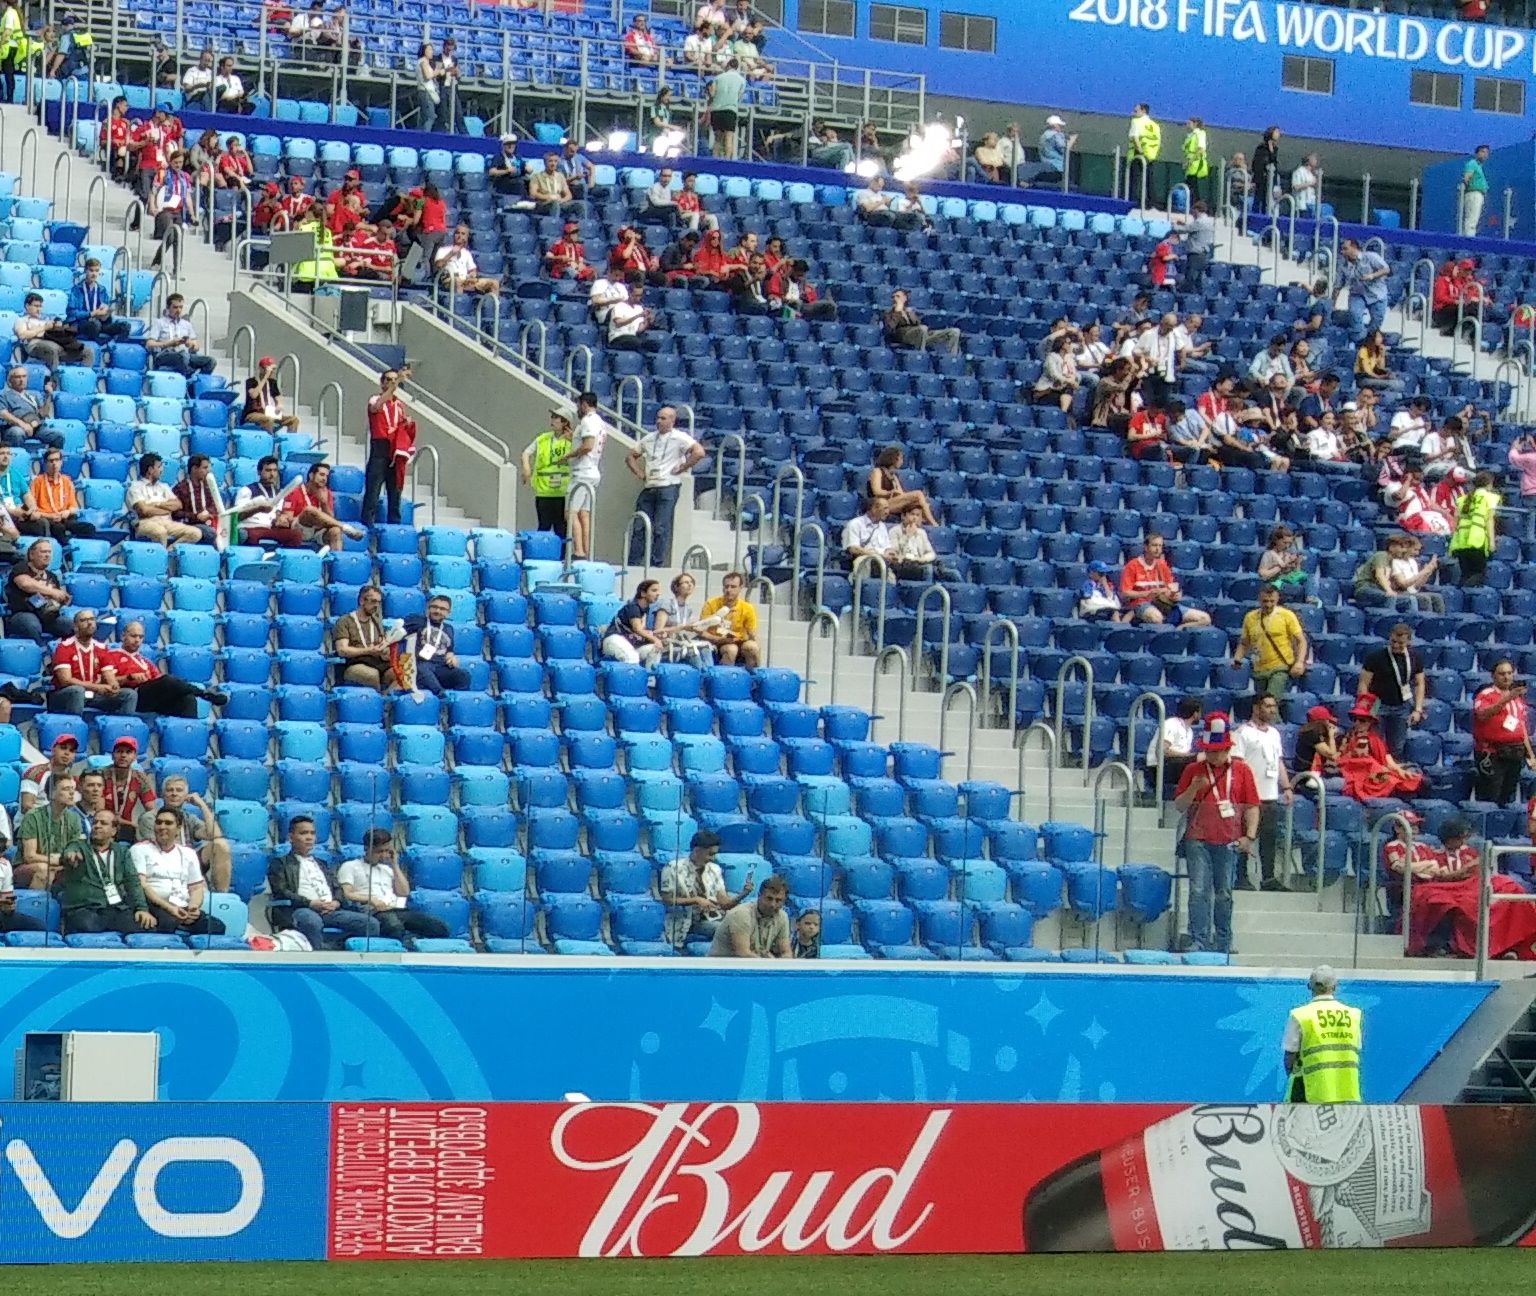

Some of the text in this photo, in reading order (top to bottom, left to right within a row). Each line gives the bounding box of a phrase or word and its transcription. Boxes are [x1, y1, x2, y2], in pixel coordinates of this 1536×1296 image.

[1068, 0, 1525, 70] 2018 FIFA WORLD CUP
[1316, 1009, 1352, 1028] 5525
[386, 1107, 445, 1255] АЛКОГОЛЯ ВРЕДИТ
[435, 1107, 495, 1255] ВАШЕМУ ЗДОРОВЬЮ
[550, 1103, 954, 1258] Bud
[1191, 1104, 1289, 1250] Bud
